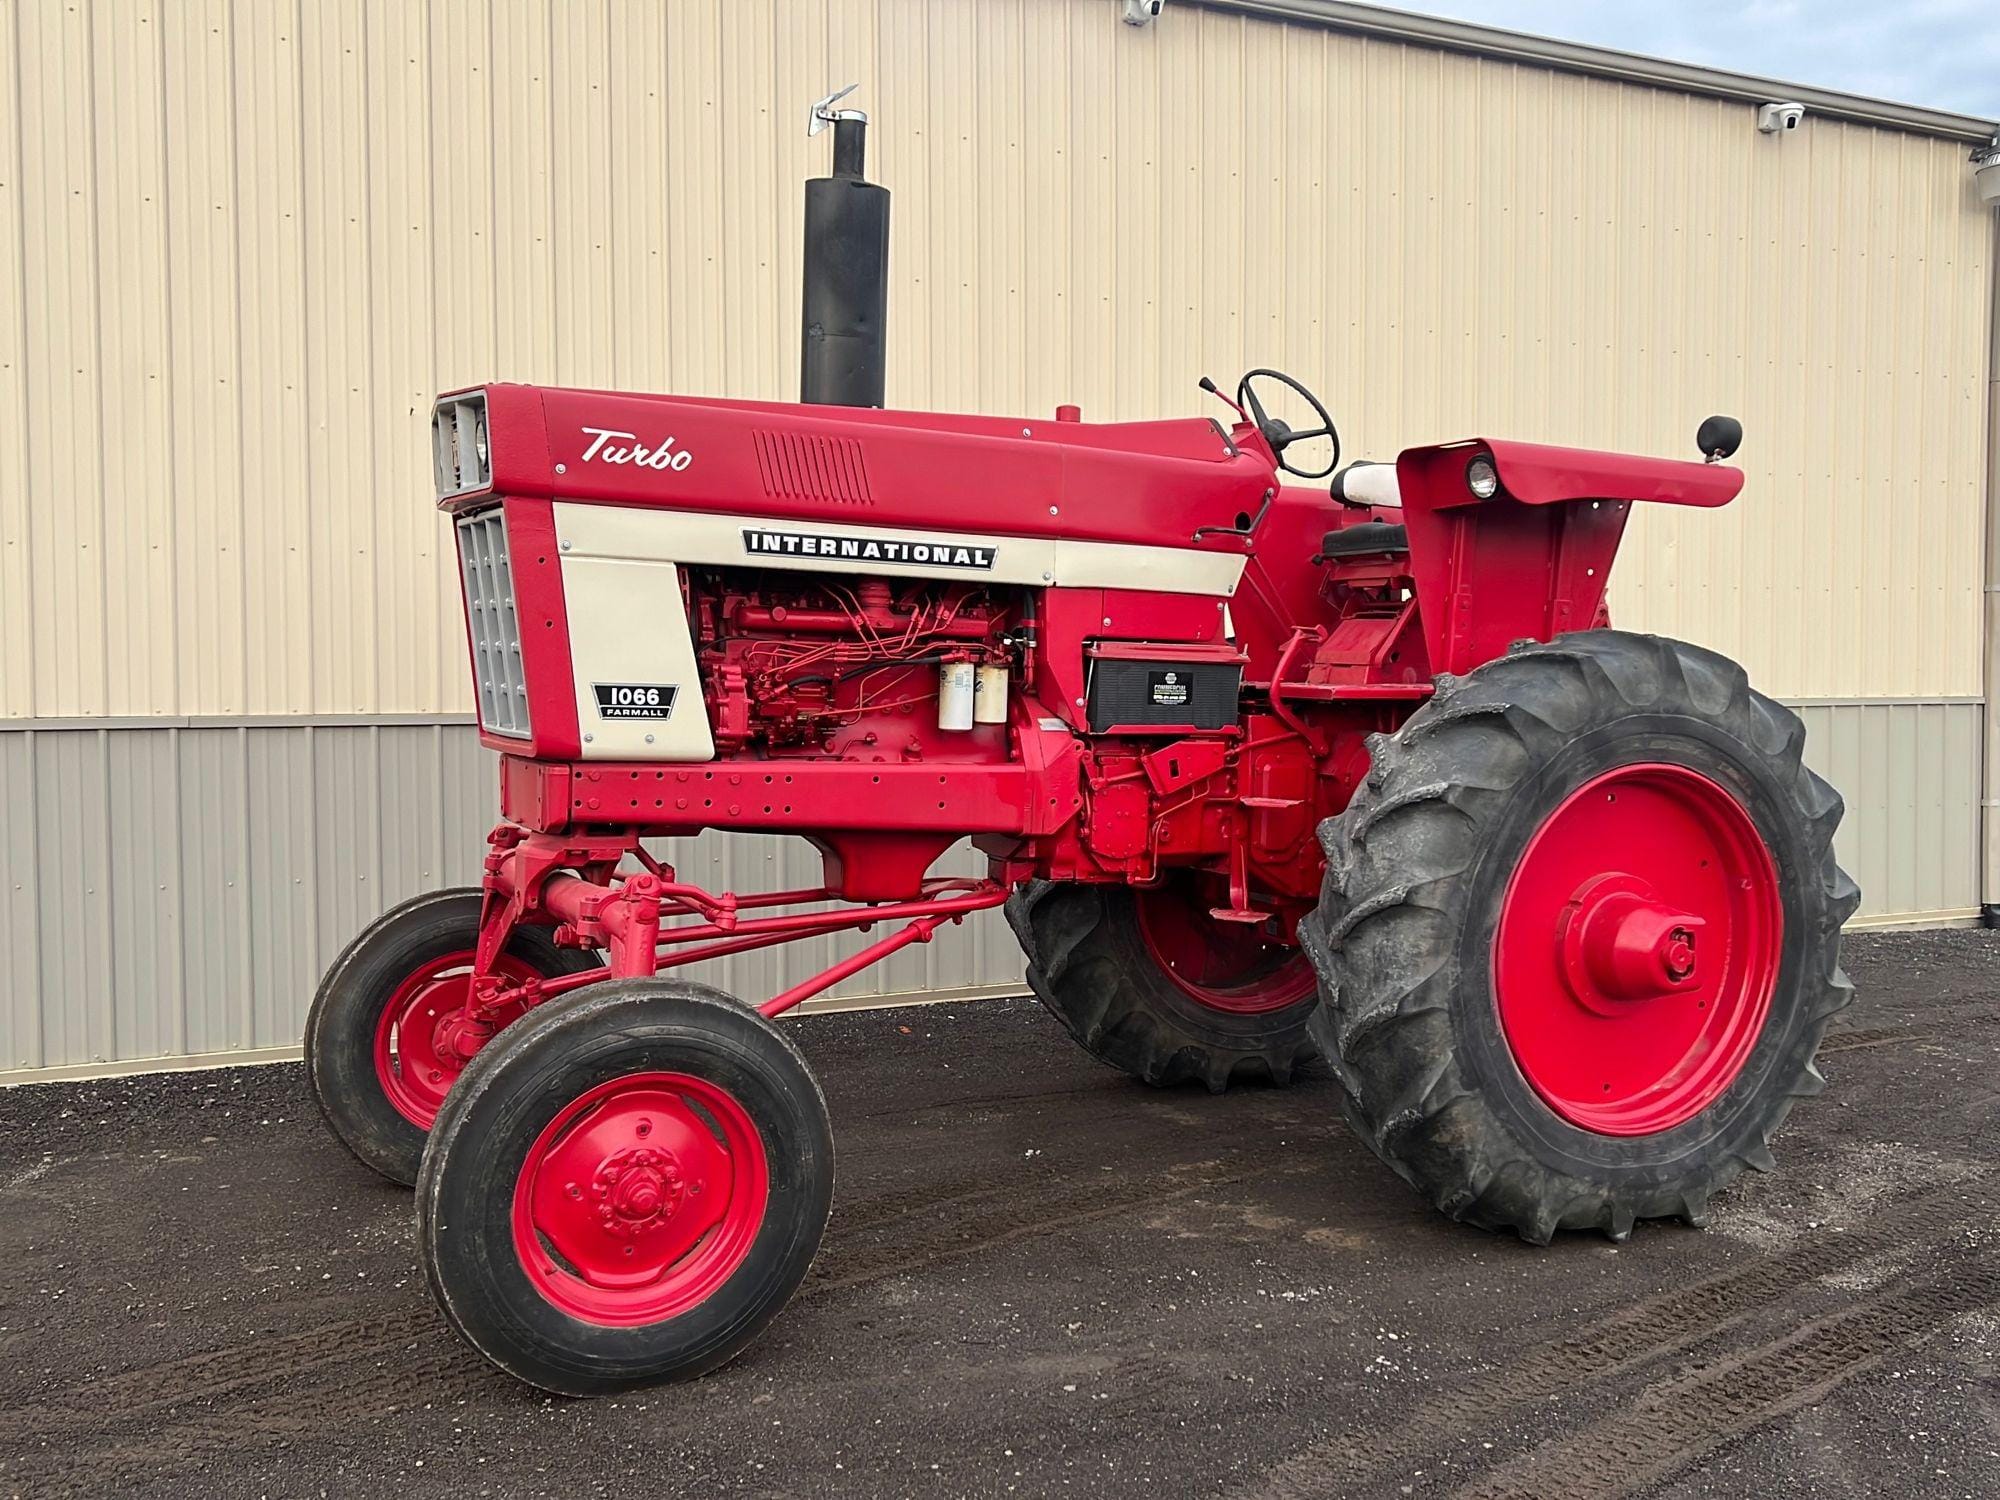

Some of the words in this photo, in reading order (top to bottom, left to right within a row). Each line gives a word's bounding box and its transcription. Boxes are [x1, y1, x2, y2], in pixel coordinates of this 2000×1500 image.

[581, 426, 693, 472] Turbo
[750, 533, 990, 566] INTERNATIONAL
[611, 687, 660, 705] 1066
[606, 709, 664, 717] FARMALL
